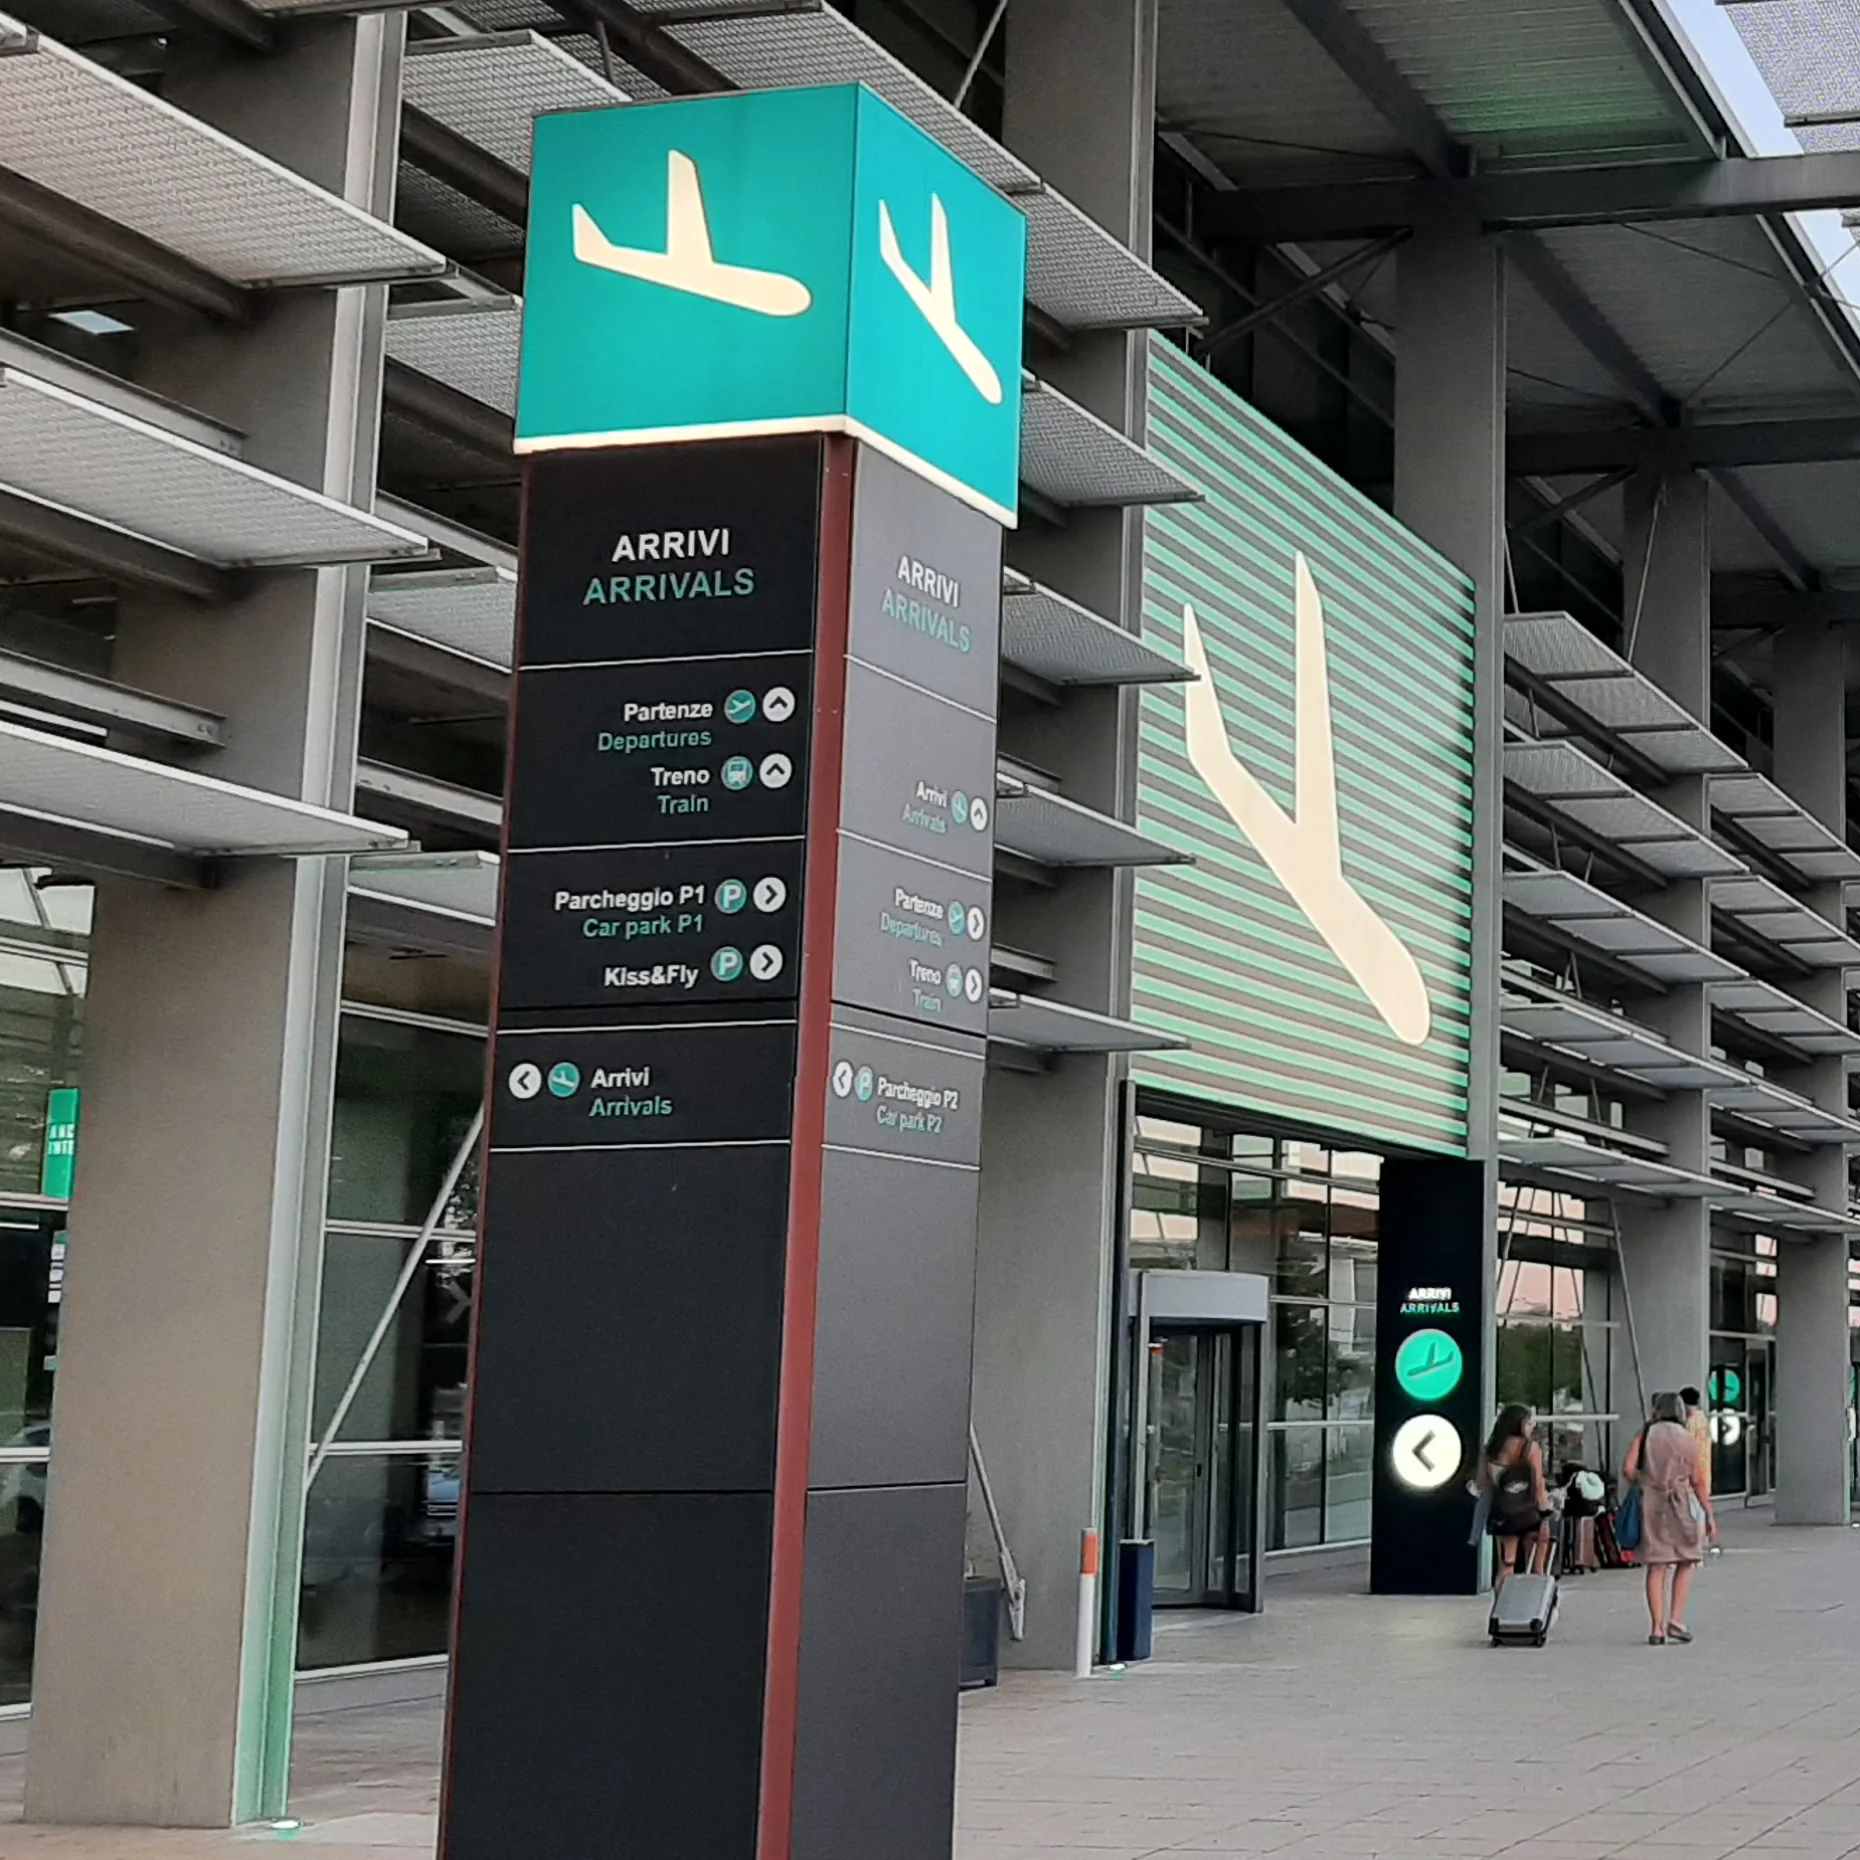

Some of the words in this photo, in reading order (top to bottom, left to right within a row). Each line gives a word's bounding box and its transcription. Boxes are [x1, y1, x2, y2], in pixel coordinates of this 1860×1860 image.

[611, 528, 730, 562] ARRIVI
[582, 568, 756, 606] ARRIVALS
[898, 555, 959, 608] ARRIVI
[881, 587, 971, 653] ARRIVALS
[623, 702, 714, 722] Partenze
[598, 731, 713, 754] Departures
[651, 766, 711, 787] Treno
[657, 794, 710, 815] Train
[555, 887, 675, 912] Parcheggio
[679, 884, 705, 905] P1
[894, 887, 944, 920] Partenze
[583, 918, 621, 938] Car
[625, 915, 672, 941] park
[677, 914, 704, 934] P1
[603, 964, 700, 990] Kiss&Fly
[908, 958, 942, 986] Treno
[590, 1066, 651, 1089] Arrivi
[588, 1095, 673, 1117] Arrivals
[877, 1076, 942, 1109] Parcheggio
[943, 1089, 959, 1110] P2
[876, 1104, 898, 1127] Car
[899, 1112, 925, 1133] park
[926, 1113, 942, 1134] P2
[1408, 1286, 1452, 1300] ARRIVI
[1400, 1301, 1460, 1314] ARRIVALS
